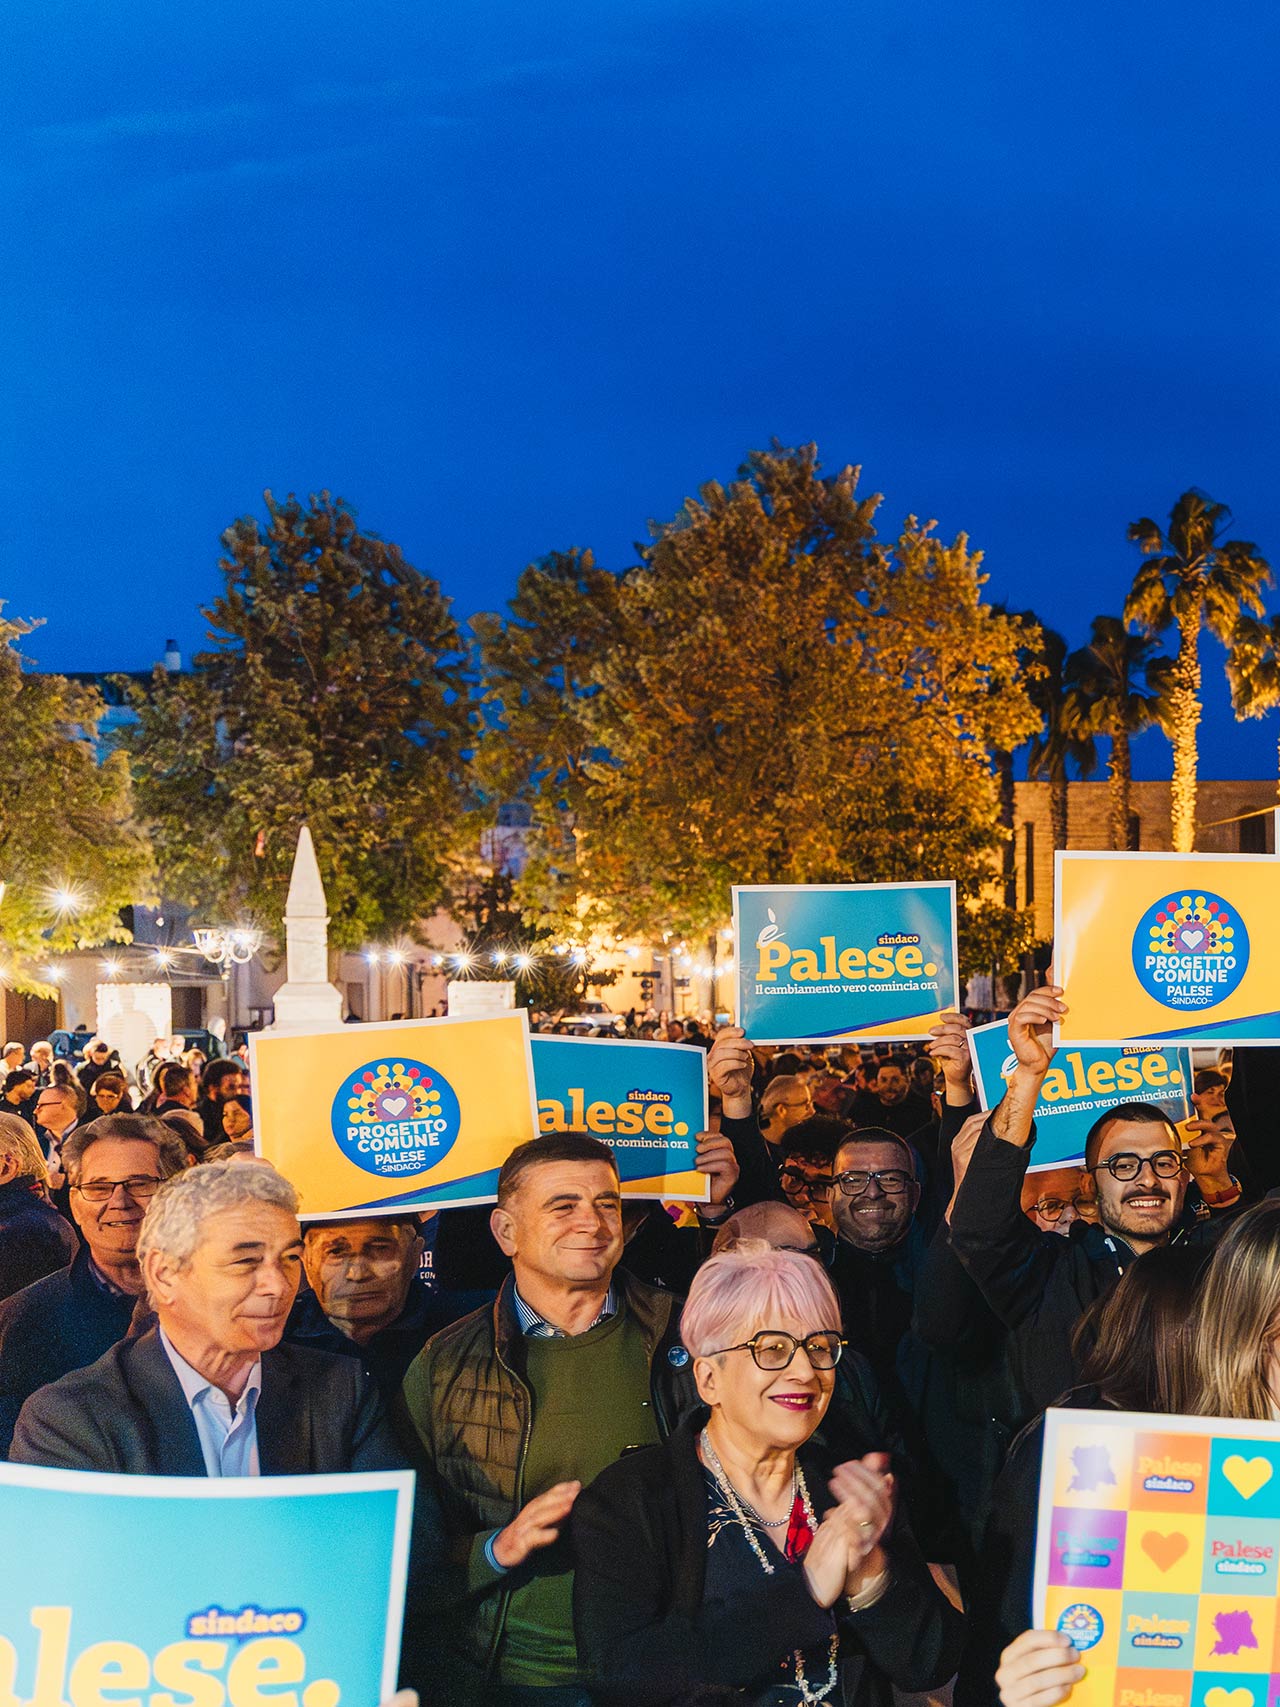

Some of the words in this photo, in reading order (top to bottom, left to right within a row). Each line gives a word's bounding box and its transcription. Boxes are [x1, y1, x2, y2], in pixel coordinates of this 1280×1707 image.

[878, 934, 919, 944] sindaco
[755, 936, 937, 981] Palese.
[1145, 956, 1236, 969] PROGETTO
[1153, 969, 1228, 982] COMUNE
[755, 985, 763, 994] Il
[764, 984, 841, 995] cambiamento
[841, 983, 869, 992] vero
[870, 980, 920, 992] comincia
[1167, 985, 1213, 996] PALESE
[1001, 1052, 1181, 1102] alese.
[628, 1091, 670, 1102] sindaco
[1094, 1098, 1119, 1108] vero
[1120, 1089, 1168, 1105] comincia
[1168, 1089, 1184, 1098] ora
[538, 1088, 689, 1136] alese.
[347, 1119, 447, 1141] PROGETTO
[357, 1132, 440, 1153] COMUNE
[616, 1137, 669, 1149] comincia
[374, 1150, 426, 1165] PALESE
[1211, 1540, 1273, 1560] Palese
[190, 1609, 302, 1635] sindaco
